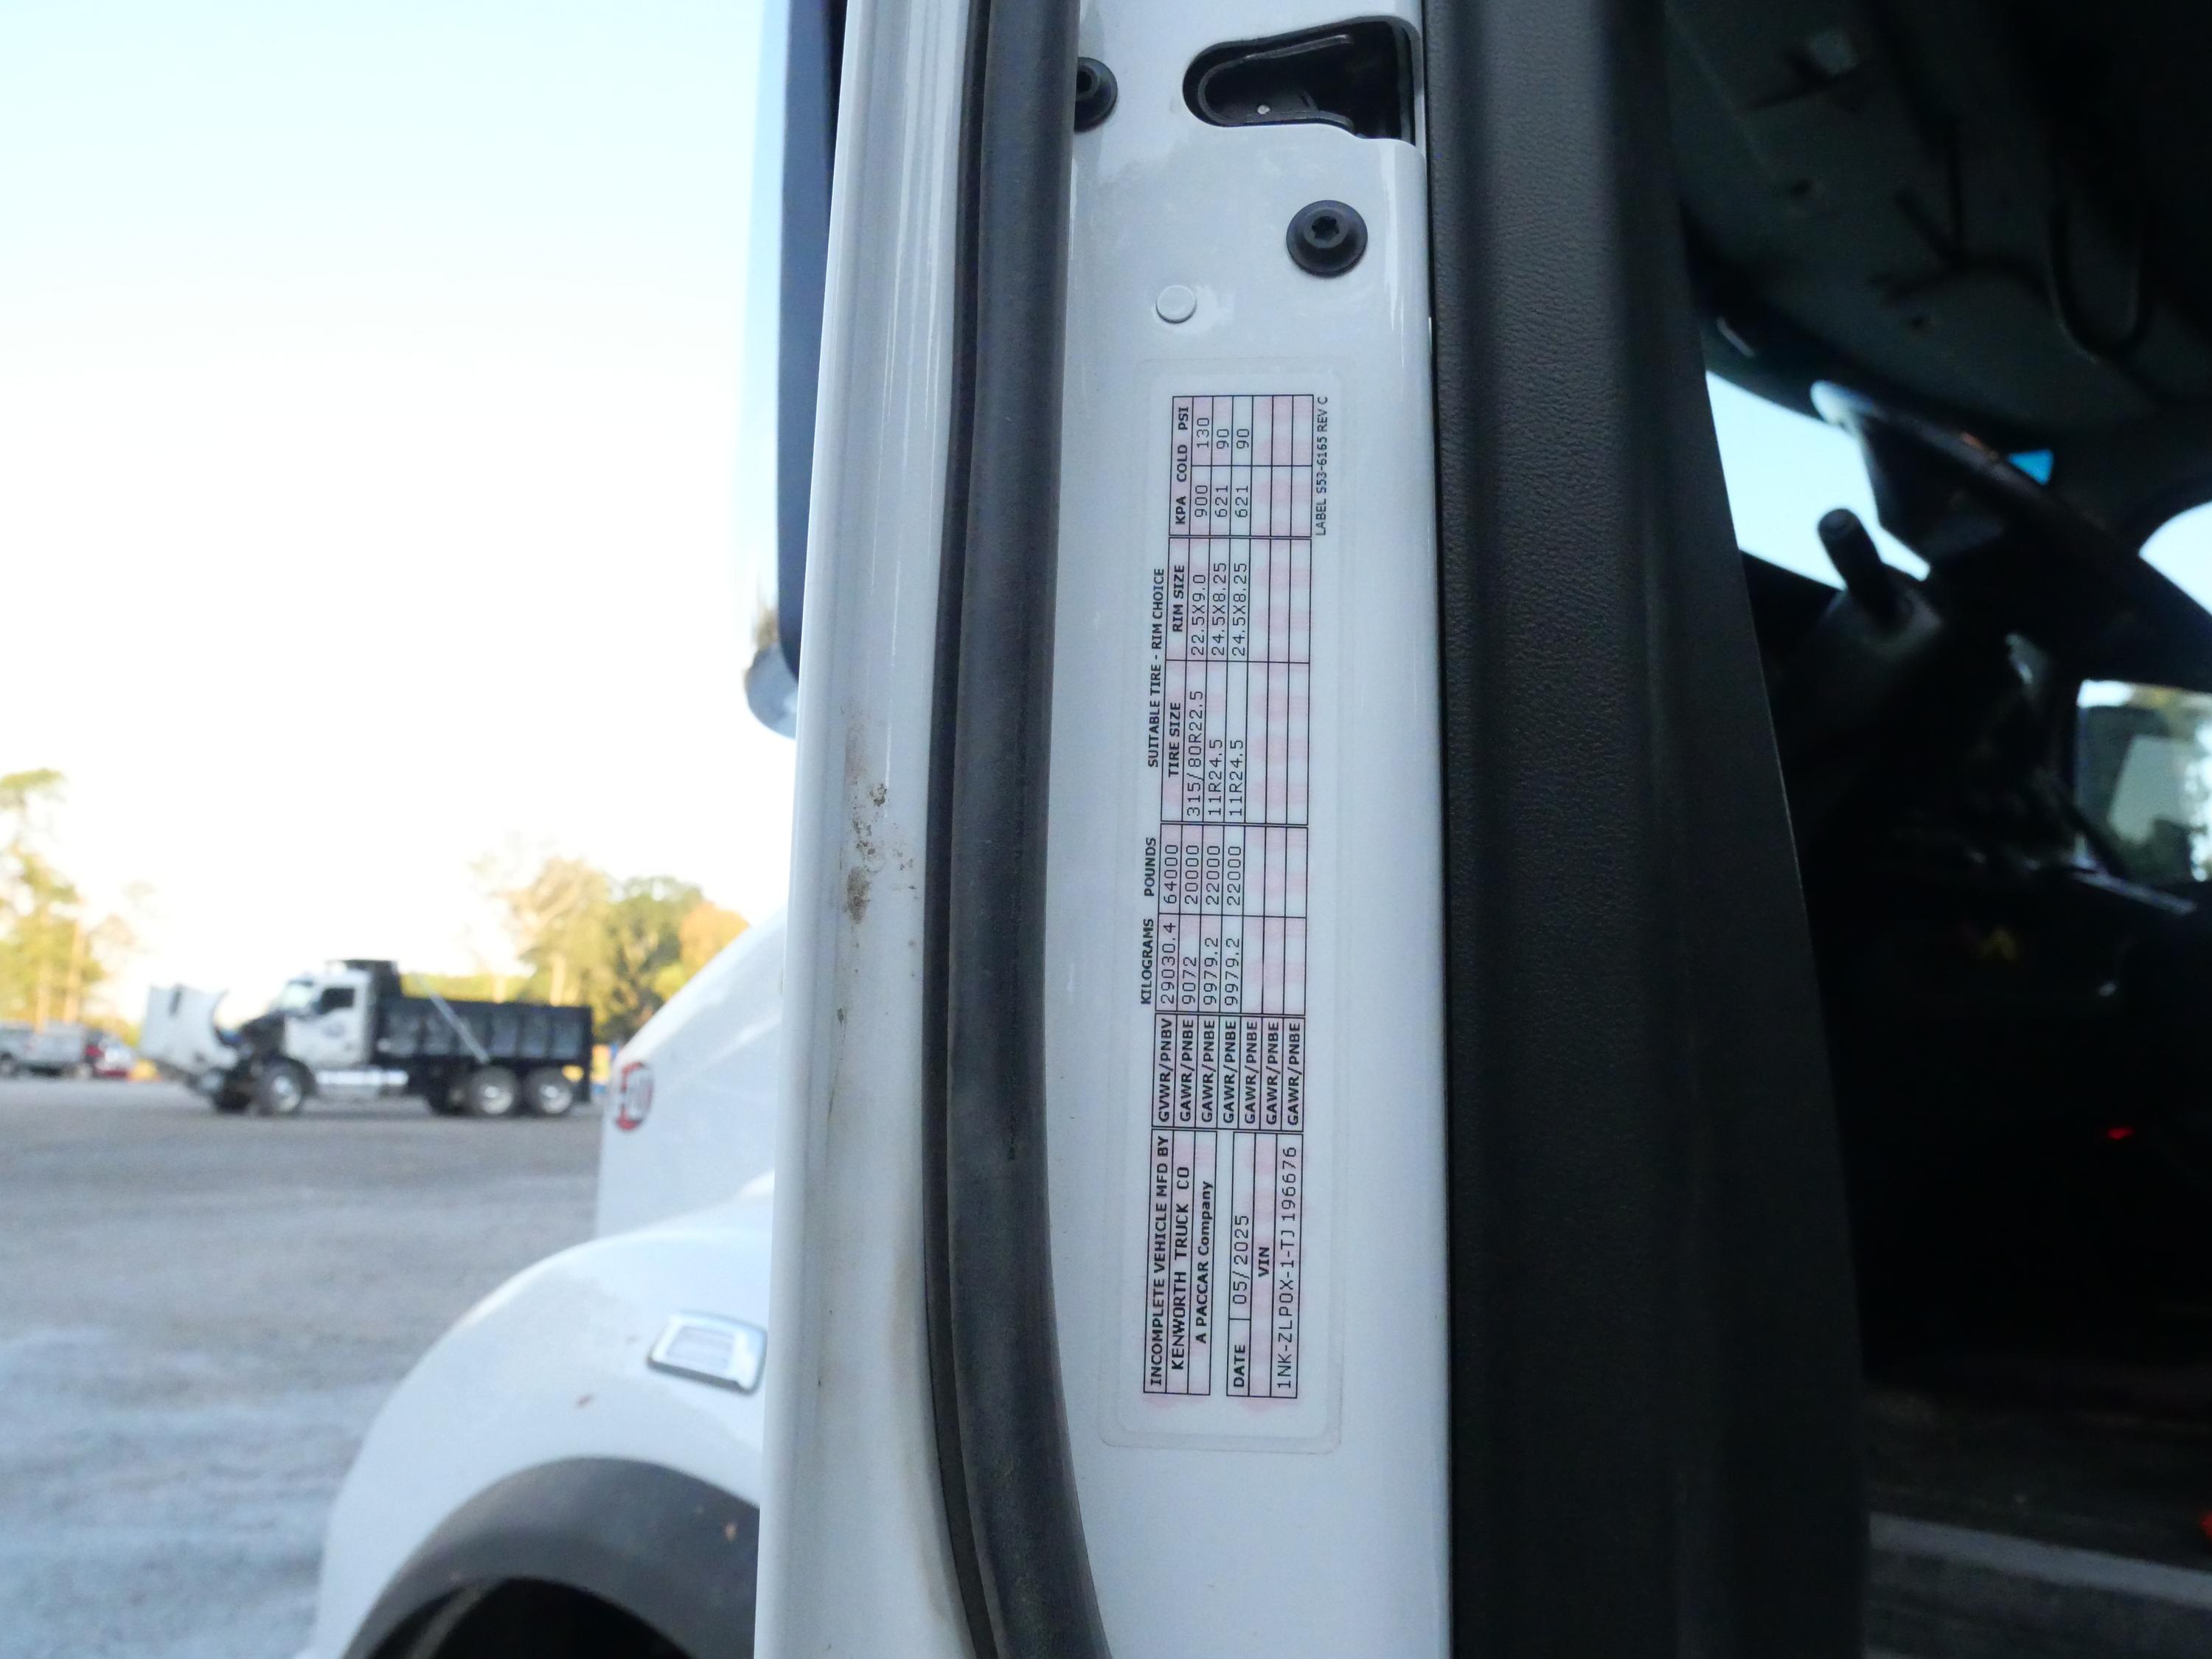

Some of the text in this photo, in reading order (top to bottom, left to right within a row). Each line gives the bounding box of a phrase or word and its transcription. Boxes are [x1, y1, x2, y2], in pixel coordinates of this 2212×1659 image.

[1175, 407, 1189, 525] KPA COLD PSI
[1196, 417, 1209, 448] 130
[1216, 428, 1229, 449] 90
[1237, 428, 1249, 449] 90
[1315, 397, 1328, 536] LABEL S53-6165 REV C
[1194, 484, 1208, 518] 900
[1214, 485, 1228, 518] 621
[1234, 485, 1248, 518] 621
[1152, 568, 1164, 619] CHOICE
[1172, 565, 1185, 633] RIM SIZE
[1191, 574, 1206, 655] 22.5X9.0
[1211, 563, 1227, 655] 24.5X8.25
[1232, 563, 1247, 656] 24.5X8.25
[1152, 623, 1162, 650] RIM
[1150, 664, 1161, 696] TIRE
[1148, 700, 1161, 768] SUITABLE
[1168, 702, 1180, 778] TIRE SIZE
[1208, 739, 1223, 816] 11R24.5
[1228, 740, 1244, 816] 11R24.5
[1144, 837, 1156, 897] POUNDS
[1164, 844, 1178, 904] 64000
[1184, 845, 1199, 905] 20000
[1206, 846, 1220, 905] 22000
[1227, 846, 1242, 905] 22000
[1141, 918, 1154, 1005] KILOGRAMS
[1161, 922, 1176, 1004] 29030.4
[1181, 956, 1197, 1004] 9072
[1203, 937, 1219, 1005] 9979.2
[1224, 938, 1239, 1006] 9979.2
[1158, 1018, 1173, 1122] GVWR/PNBV
[1180, 1018, 1194, 1122] GAWR/PNBE
[1201, 1019, 1217, 1123] GAWR/PNBE
[1222, 1020, 1238, 1124] GAWR/PNBE
[1244, 1020, 1259, 1124] GAWR/PNBE
[1265, 1021, 1281, 1125] GAWR/PNBE
[1287, 1023, 1302, 1125] GAWR/PNBE
[1150, 1135, 1168, 1386] INCOMPLETE VEHICLE MFD BY
[1172, 1167, 1190, 1370] KENWORTH TRUCK CO
[1195, 1181, 1213, 1344] A PACCAR Company
[1259, 1247, 1270, 1277] VIN
[1234, 1344, 1245, 1388] DATE
